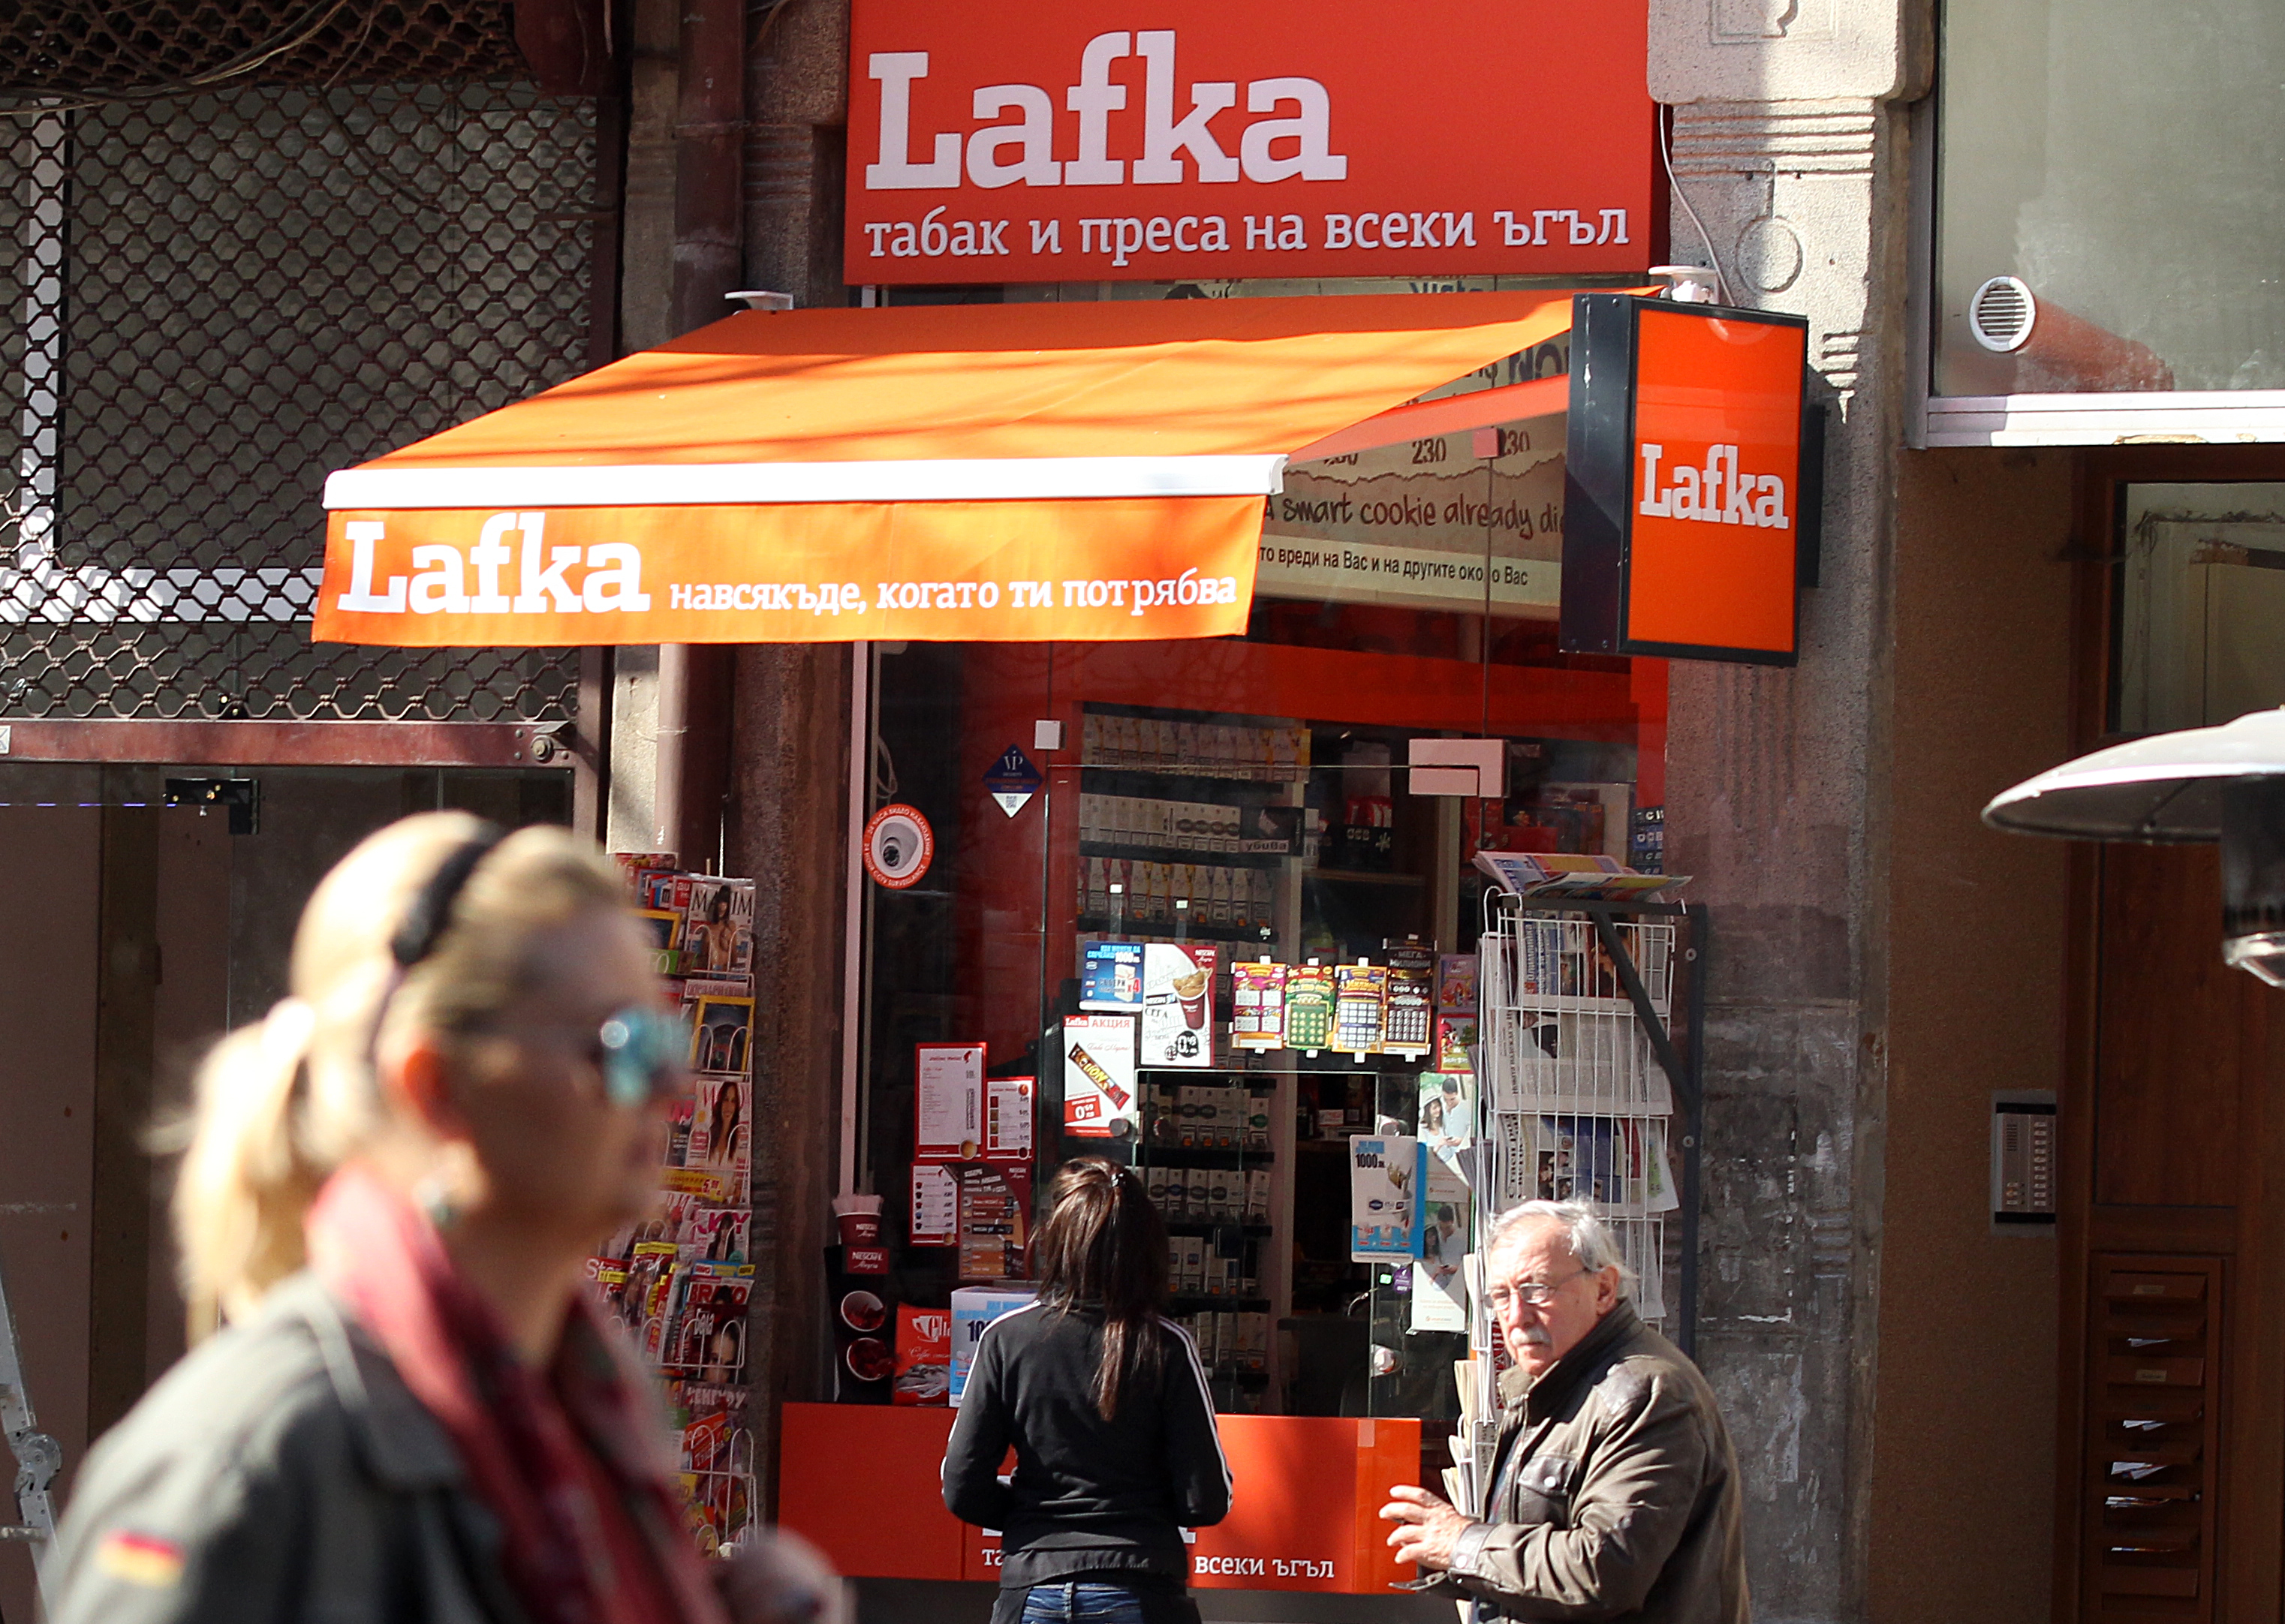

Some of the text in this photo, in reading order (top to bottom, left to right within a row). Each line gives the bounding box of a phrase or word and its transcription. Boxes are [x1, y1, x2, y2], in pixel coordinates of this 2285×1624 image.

[865, 29, 1347, 191] Lafka
[864, 205, 1630, 266] табак и преса на всеки ъгъл
[1411, 437, 1447, 465] 230
[1639, 443, 1790, 530] Lafka
[1282, 492, 1354, 525] smart
[1360, 493, 1437, 527] cookie
[1444, 492, 1534, 540] already
[336, 512, 651, 615] Lafka
[1278, 549, 1319, 569] вреди
[1323, 552, 1339, 568] на
[1344, 550, 1368, 571] Вас
[1371, 558, 1380, 571] и
[1384, 558, 1400, 573] на
[1403, 559, 1456, 581] другите
[1459, 565, 1500, 582] окоо
[1504, 565, 1528, 586] Вас
[670, 567, 1237, 616] навсякъде, когато ти потрябва
[691, 889, 753, 916] MAIM
[1091, 1018, 1130, 1030] АКЦИЯ
[1355, 1153, 1377, 1168] 1000
[689, 1283, 748, 1305] BRO
[1194, 1554, 1265, 1577] всеки
[1272, 1558, 1335, 1578] ъгъл
